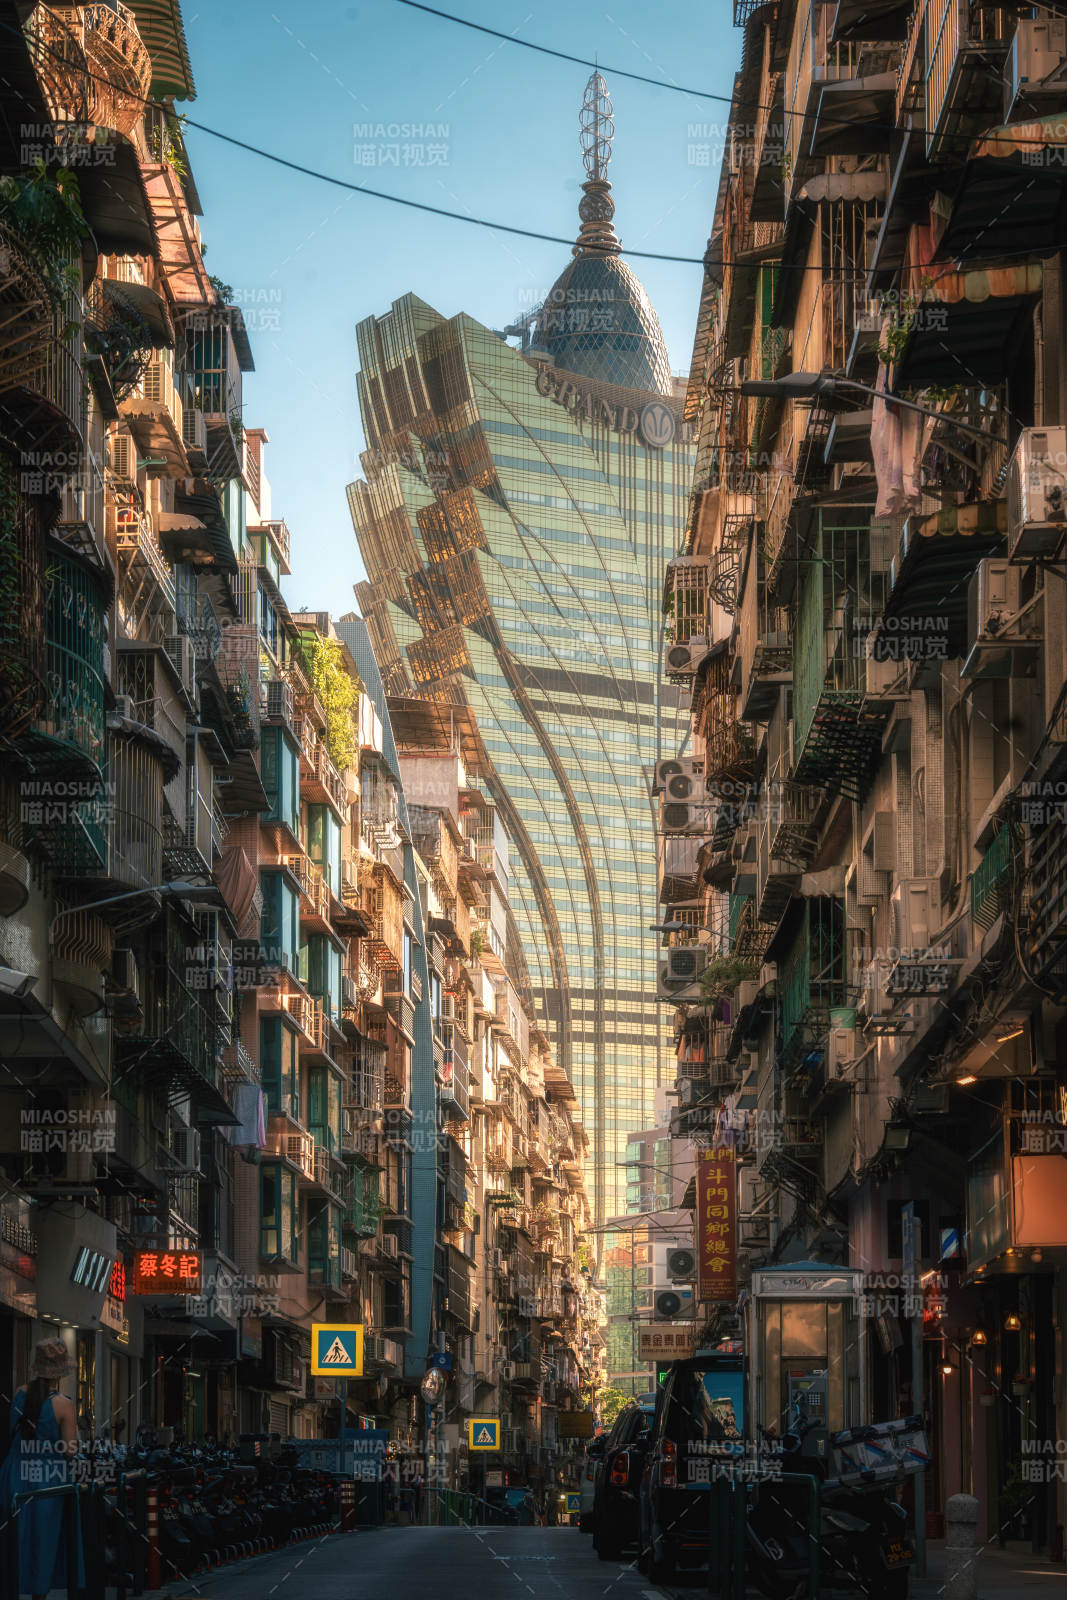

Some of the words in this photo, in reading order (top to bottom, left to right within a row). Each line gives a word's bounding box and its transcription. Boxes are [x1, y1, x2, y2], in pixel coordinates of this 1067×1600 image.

[536, 368, 639, 433] GRAND
[705, 1168, 731, 1273] 斗門同鄉總會
[139, 1252, 199, 1279] 蔡冬記
